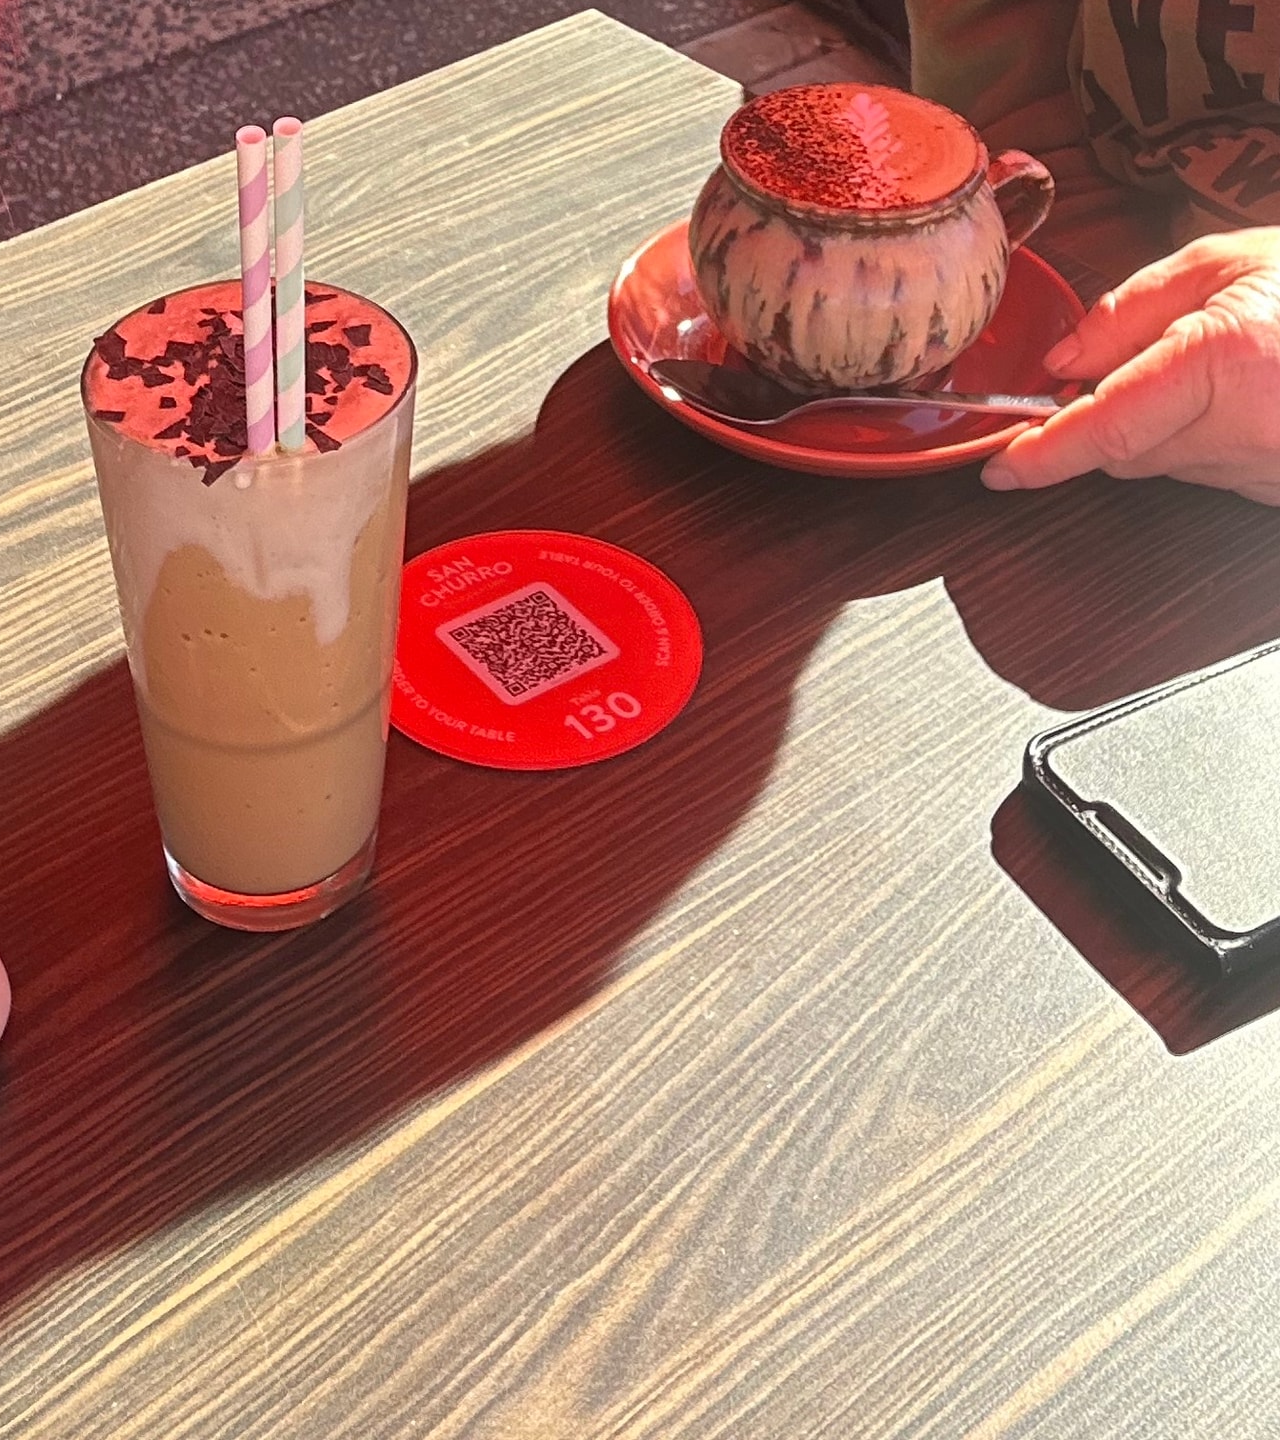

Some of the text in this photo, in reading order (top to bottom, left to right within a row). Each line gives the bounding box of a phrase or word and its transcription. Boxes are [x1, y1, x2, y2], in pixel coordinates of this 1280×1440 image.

[420, 561, 513, 607] CHURRO
[426, 556, 474, 584] SAN
[582, 560, 620, 582] YOUR
[411, 694, 429, 709] TO
[428, 705, 468, 731] YOUR
[469, 723, 517, 743] TABLE
[564, 691, 642, 740] 130
